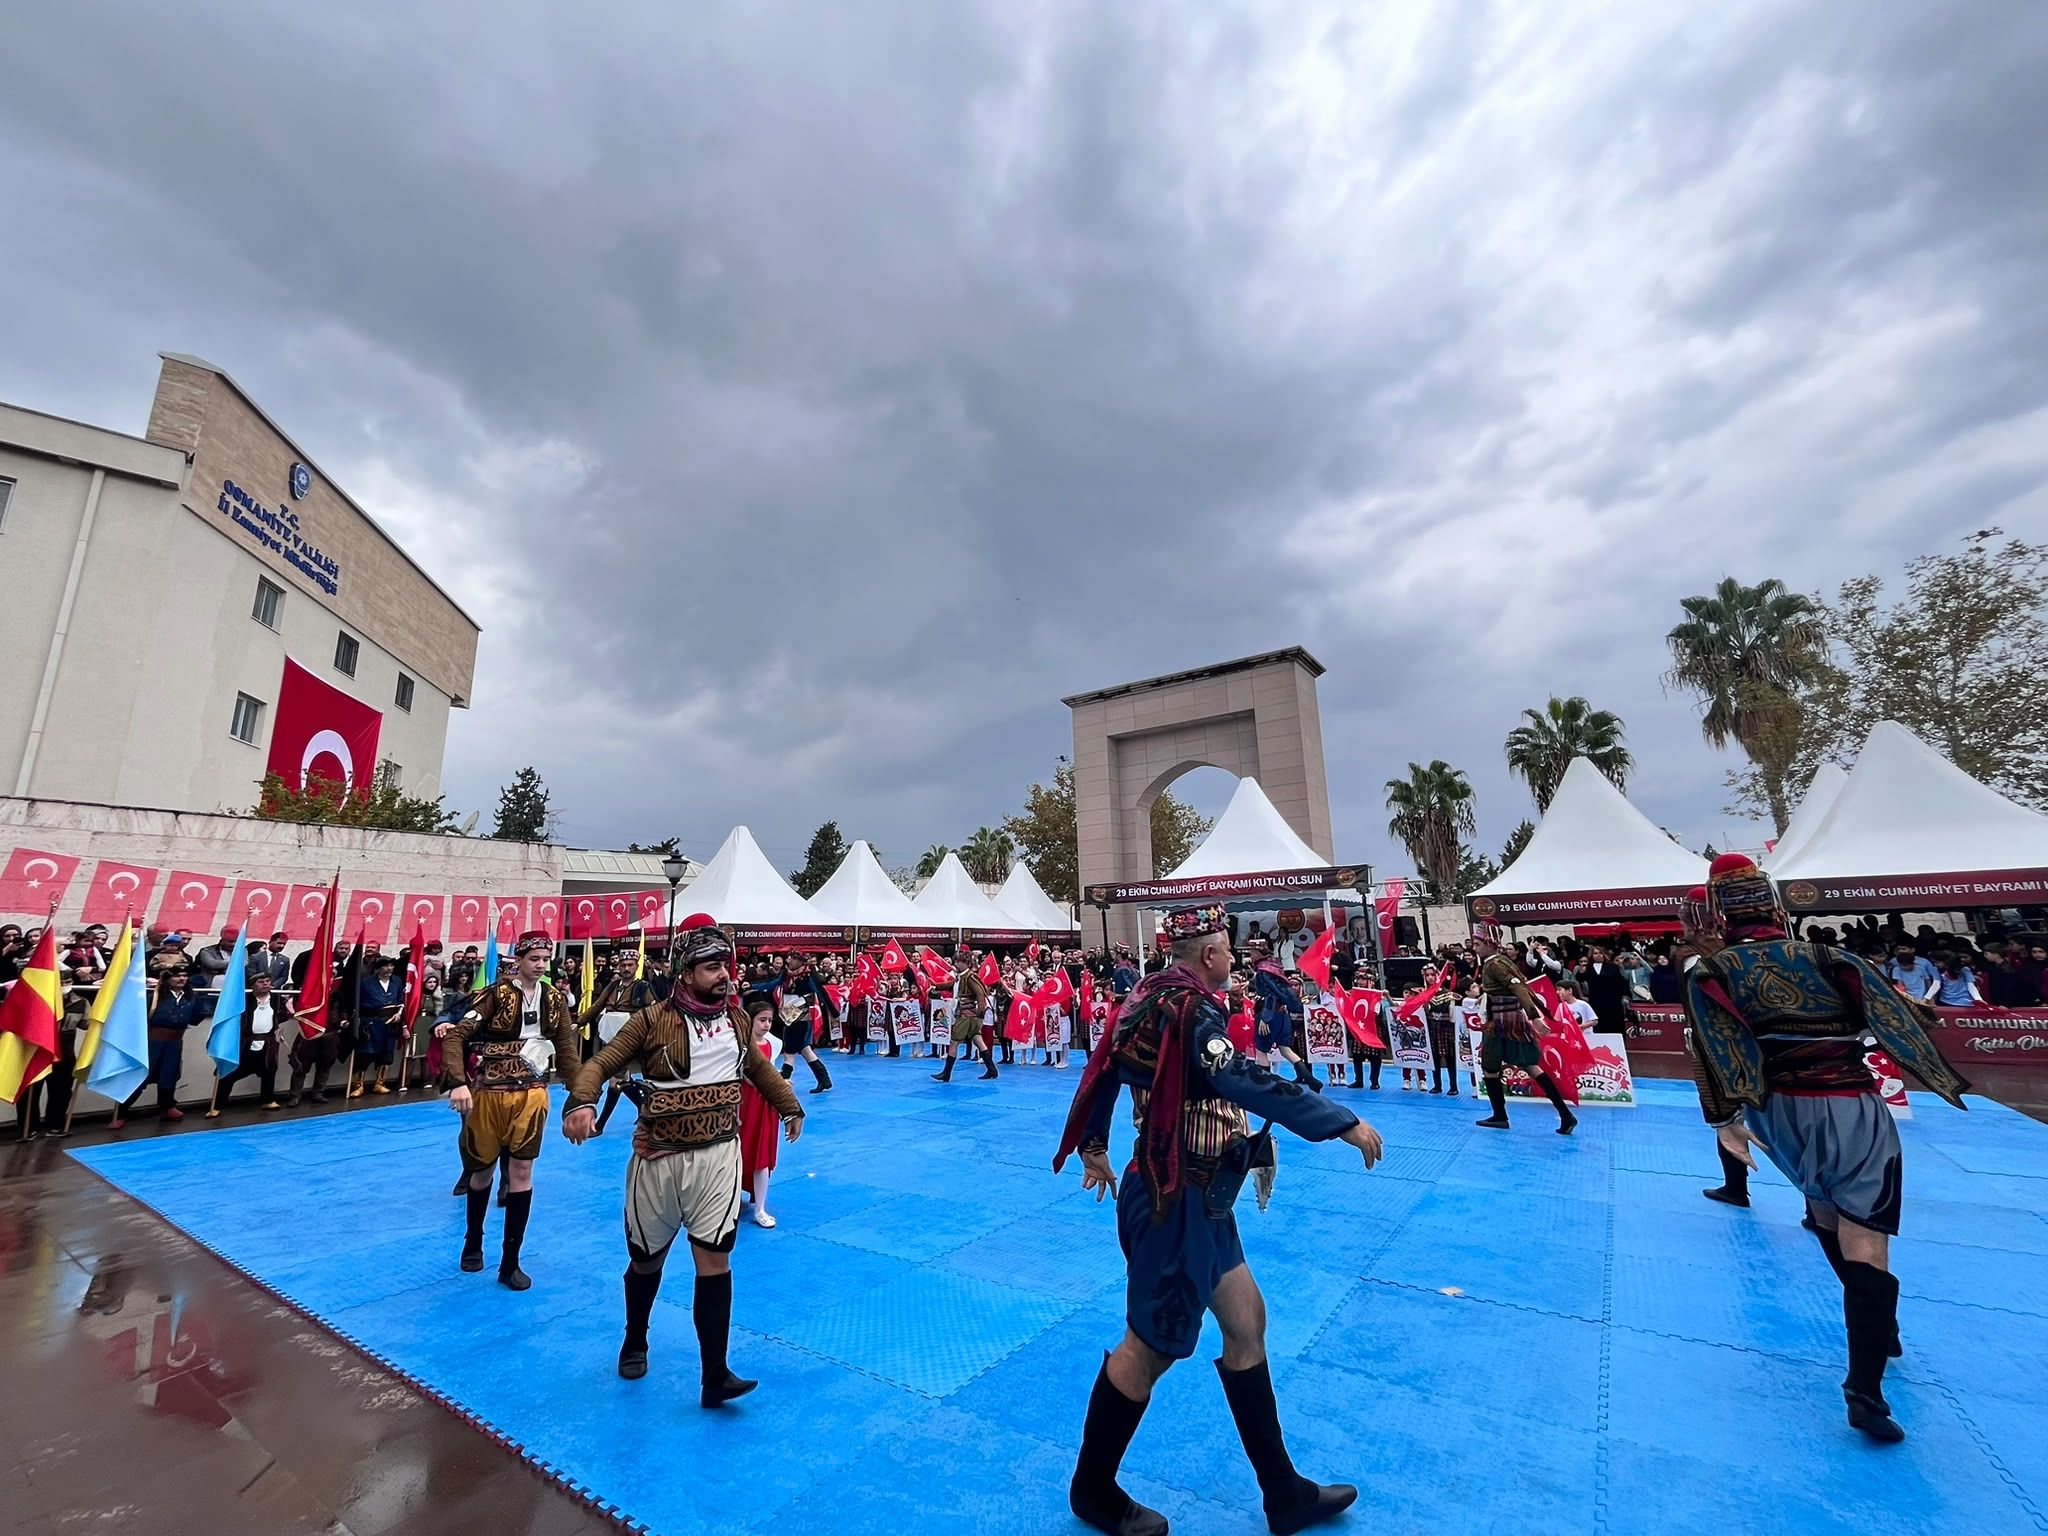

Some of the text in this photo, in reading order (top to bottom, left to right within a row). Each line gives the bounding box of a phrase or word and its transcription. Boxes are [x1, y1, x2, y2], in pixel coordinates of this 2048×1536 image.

[223, 479, 339, 580] OSMANİYE VALİLİĞİ
[231, 505, 283, 554] Emniyet
[1116, 874, 1323, 897] 29 EKİM CUMHURİYET BAYRAMI KUTLU OLSUN
[1824, 889, 1840, 898] 29
[1843, 887, 1876, 898] EKİM
[1878, 883, 1970, 897] CUMHURİYET
[1973, 880, 2041, 893] BAYRAMI
[1500, 904, 1511, 912] 29
[1513, 902, 1536, 911] EKİM
[1538, 900, 1602, 910] CUMHURİYET
[1604, 898, 1651, 908] BAYRAMI
